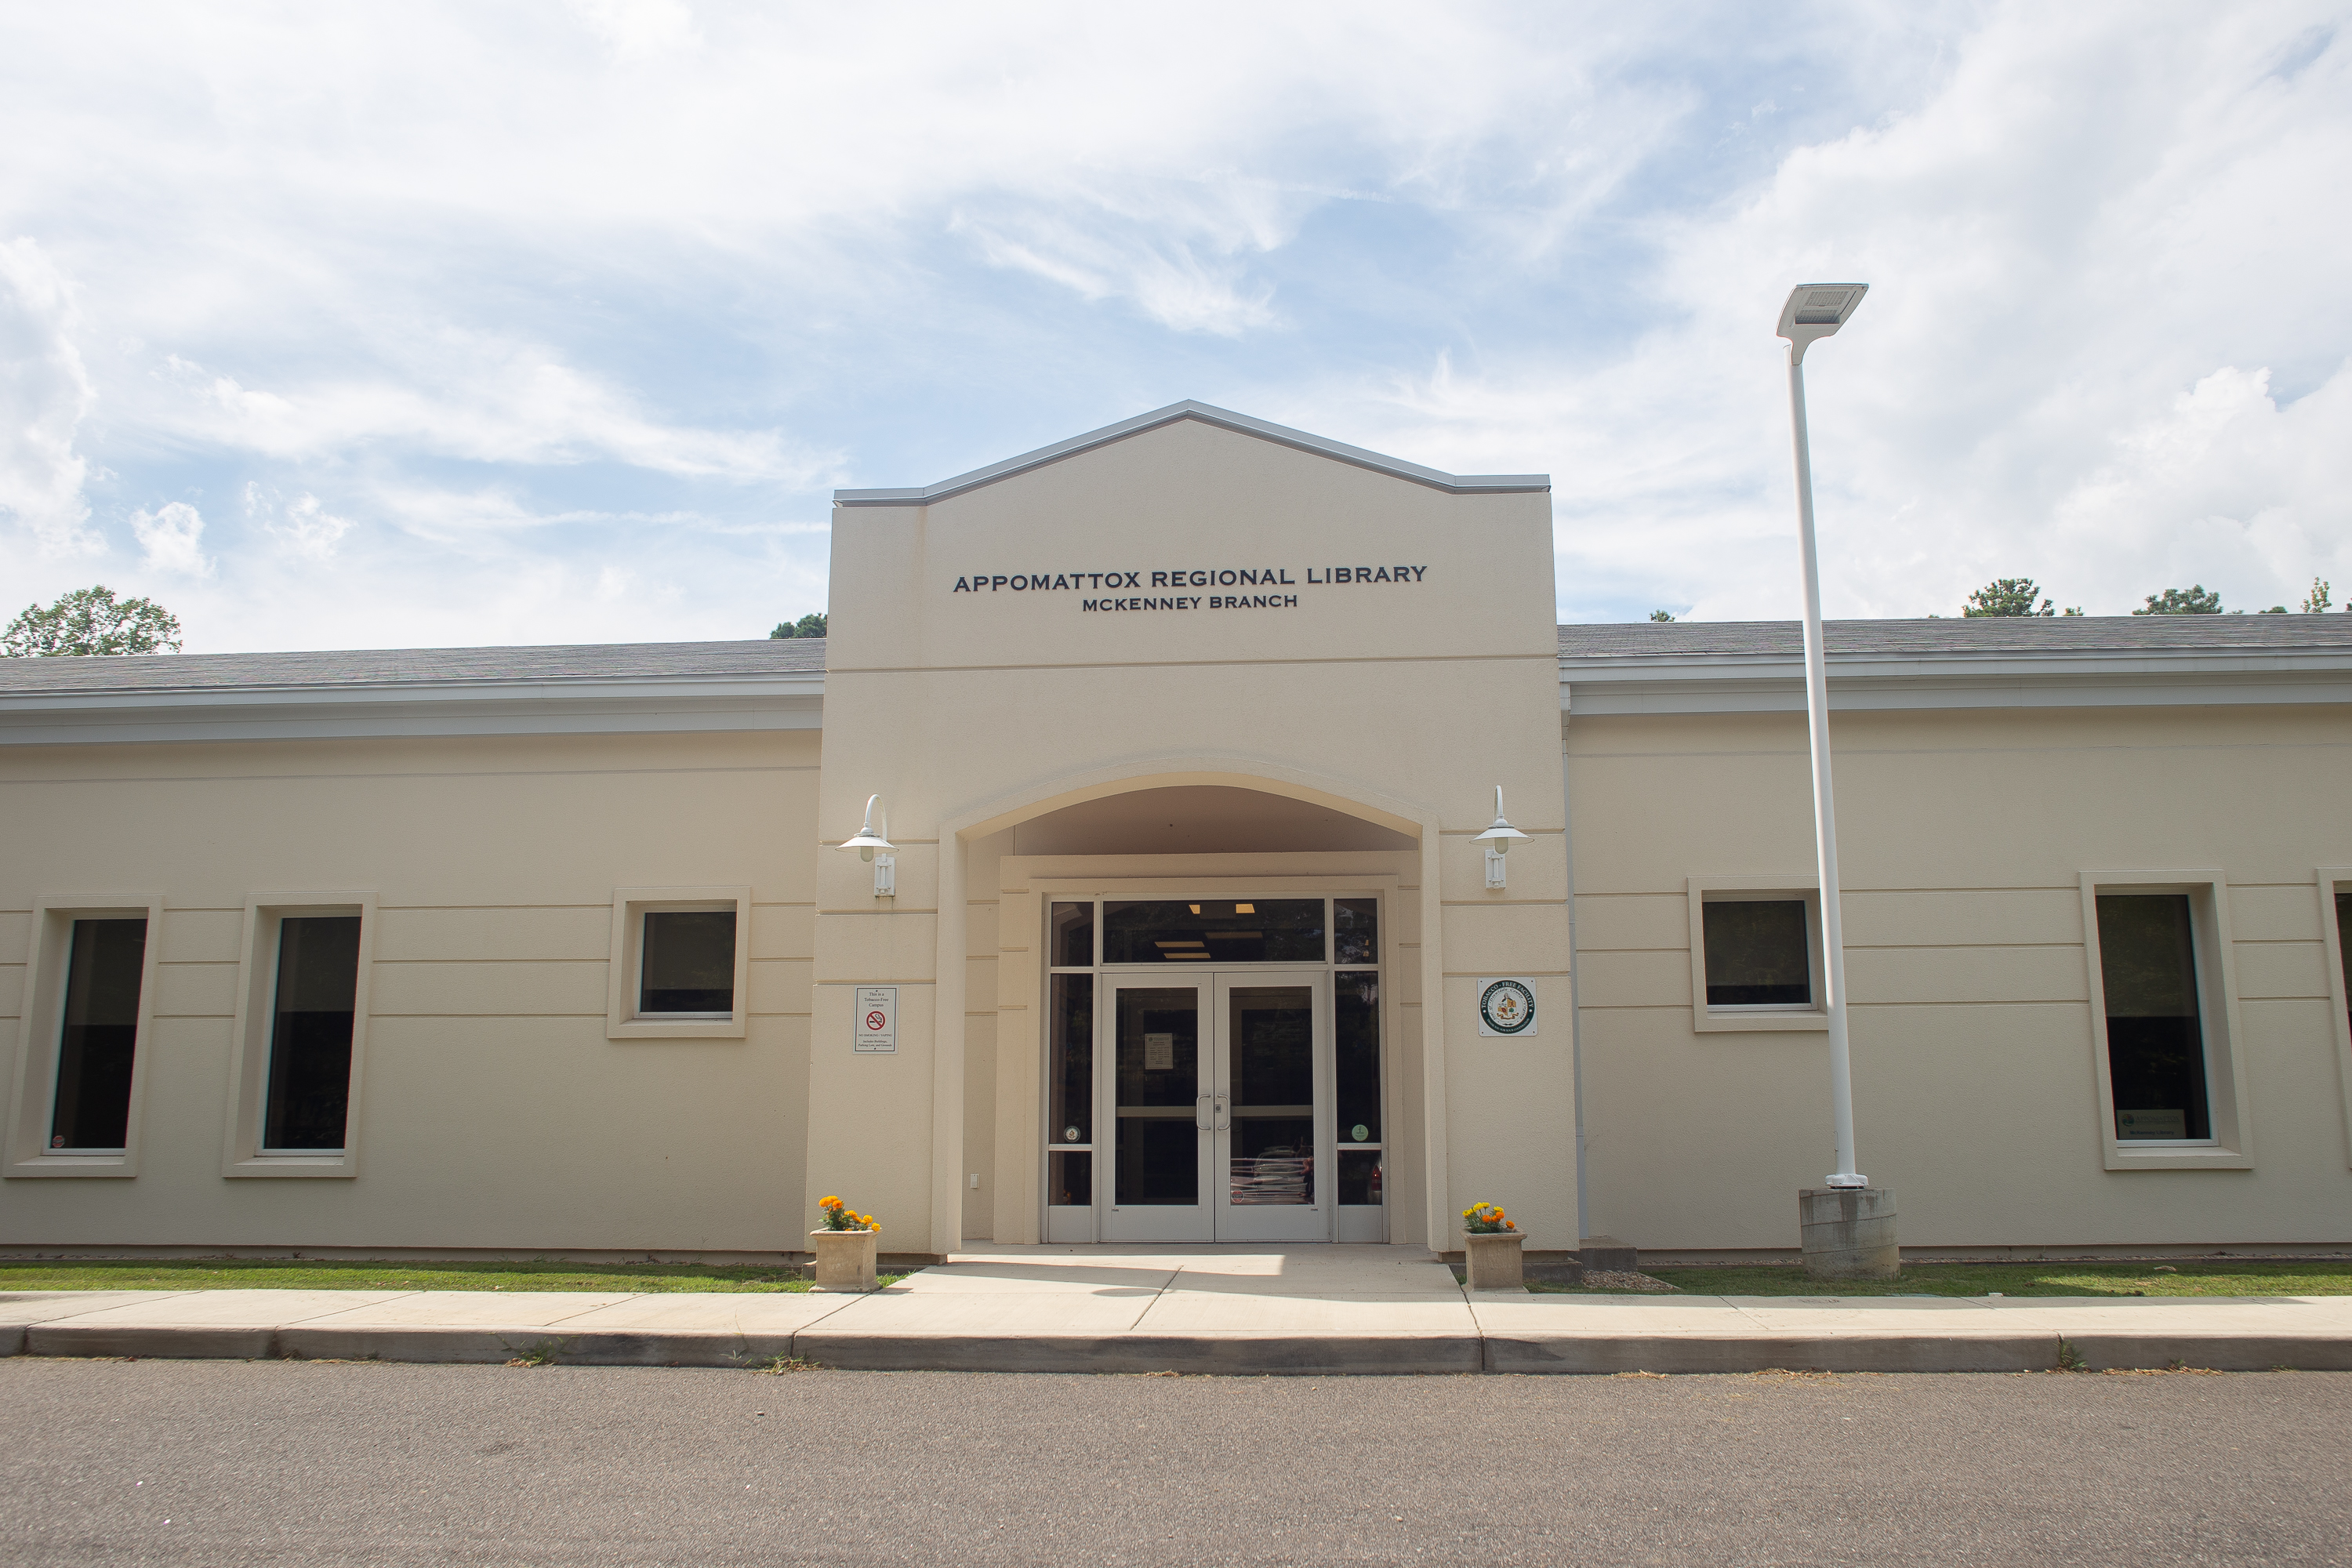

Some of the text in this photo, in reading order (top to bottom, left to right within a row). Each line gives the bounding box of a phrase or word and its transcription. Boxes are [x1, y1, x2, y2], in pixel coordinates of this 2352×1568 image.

[953, 565, 1428, 592] APPOMATTOX REGIONAL LIBRARY
[1083, 594, 1298, 612] MCKENNEY BRANCH
[1481, 984, 1498, 1009] TOBACCO
[1517, 985, 1534, 1008] FACILITY
